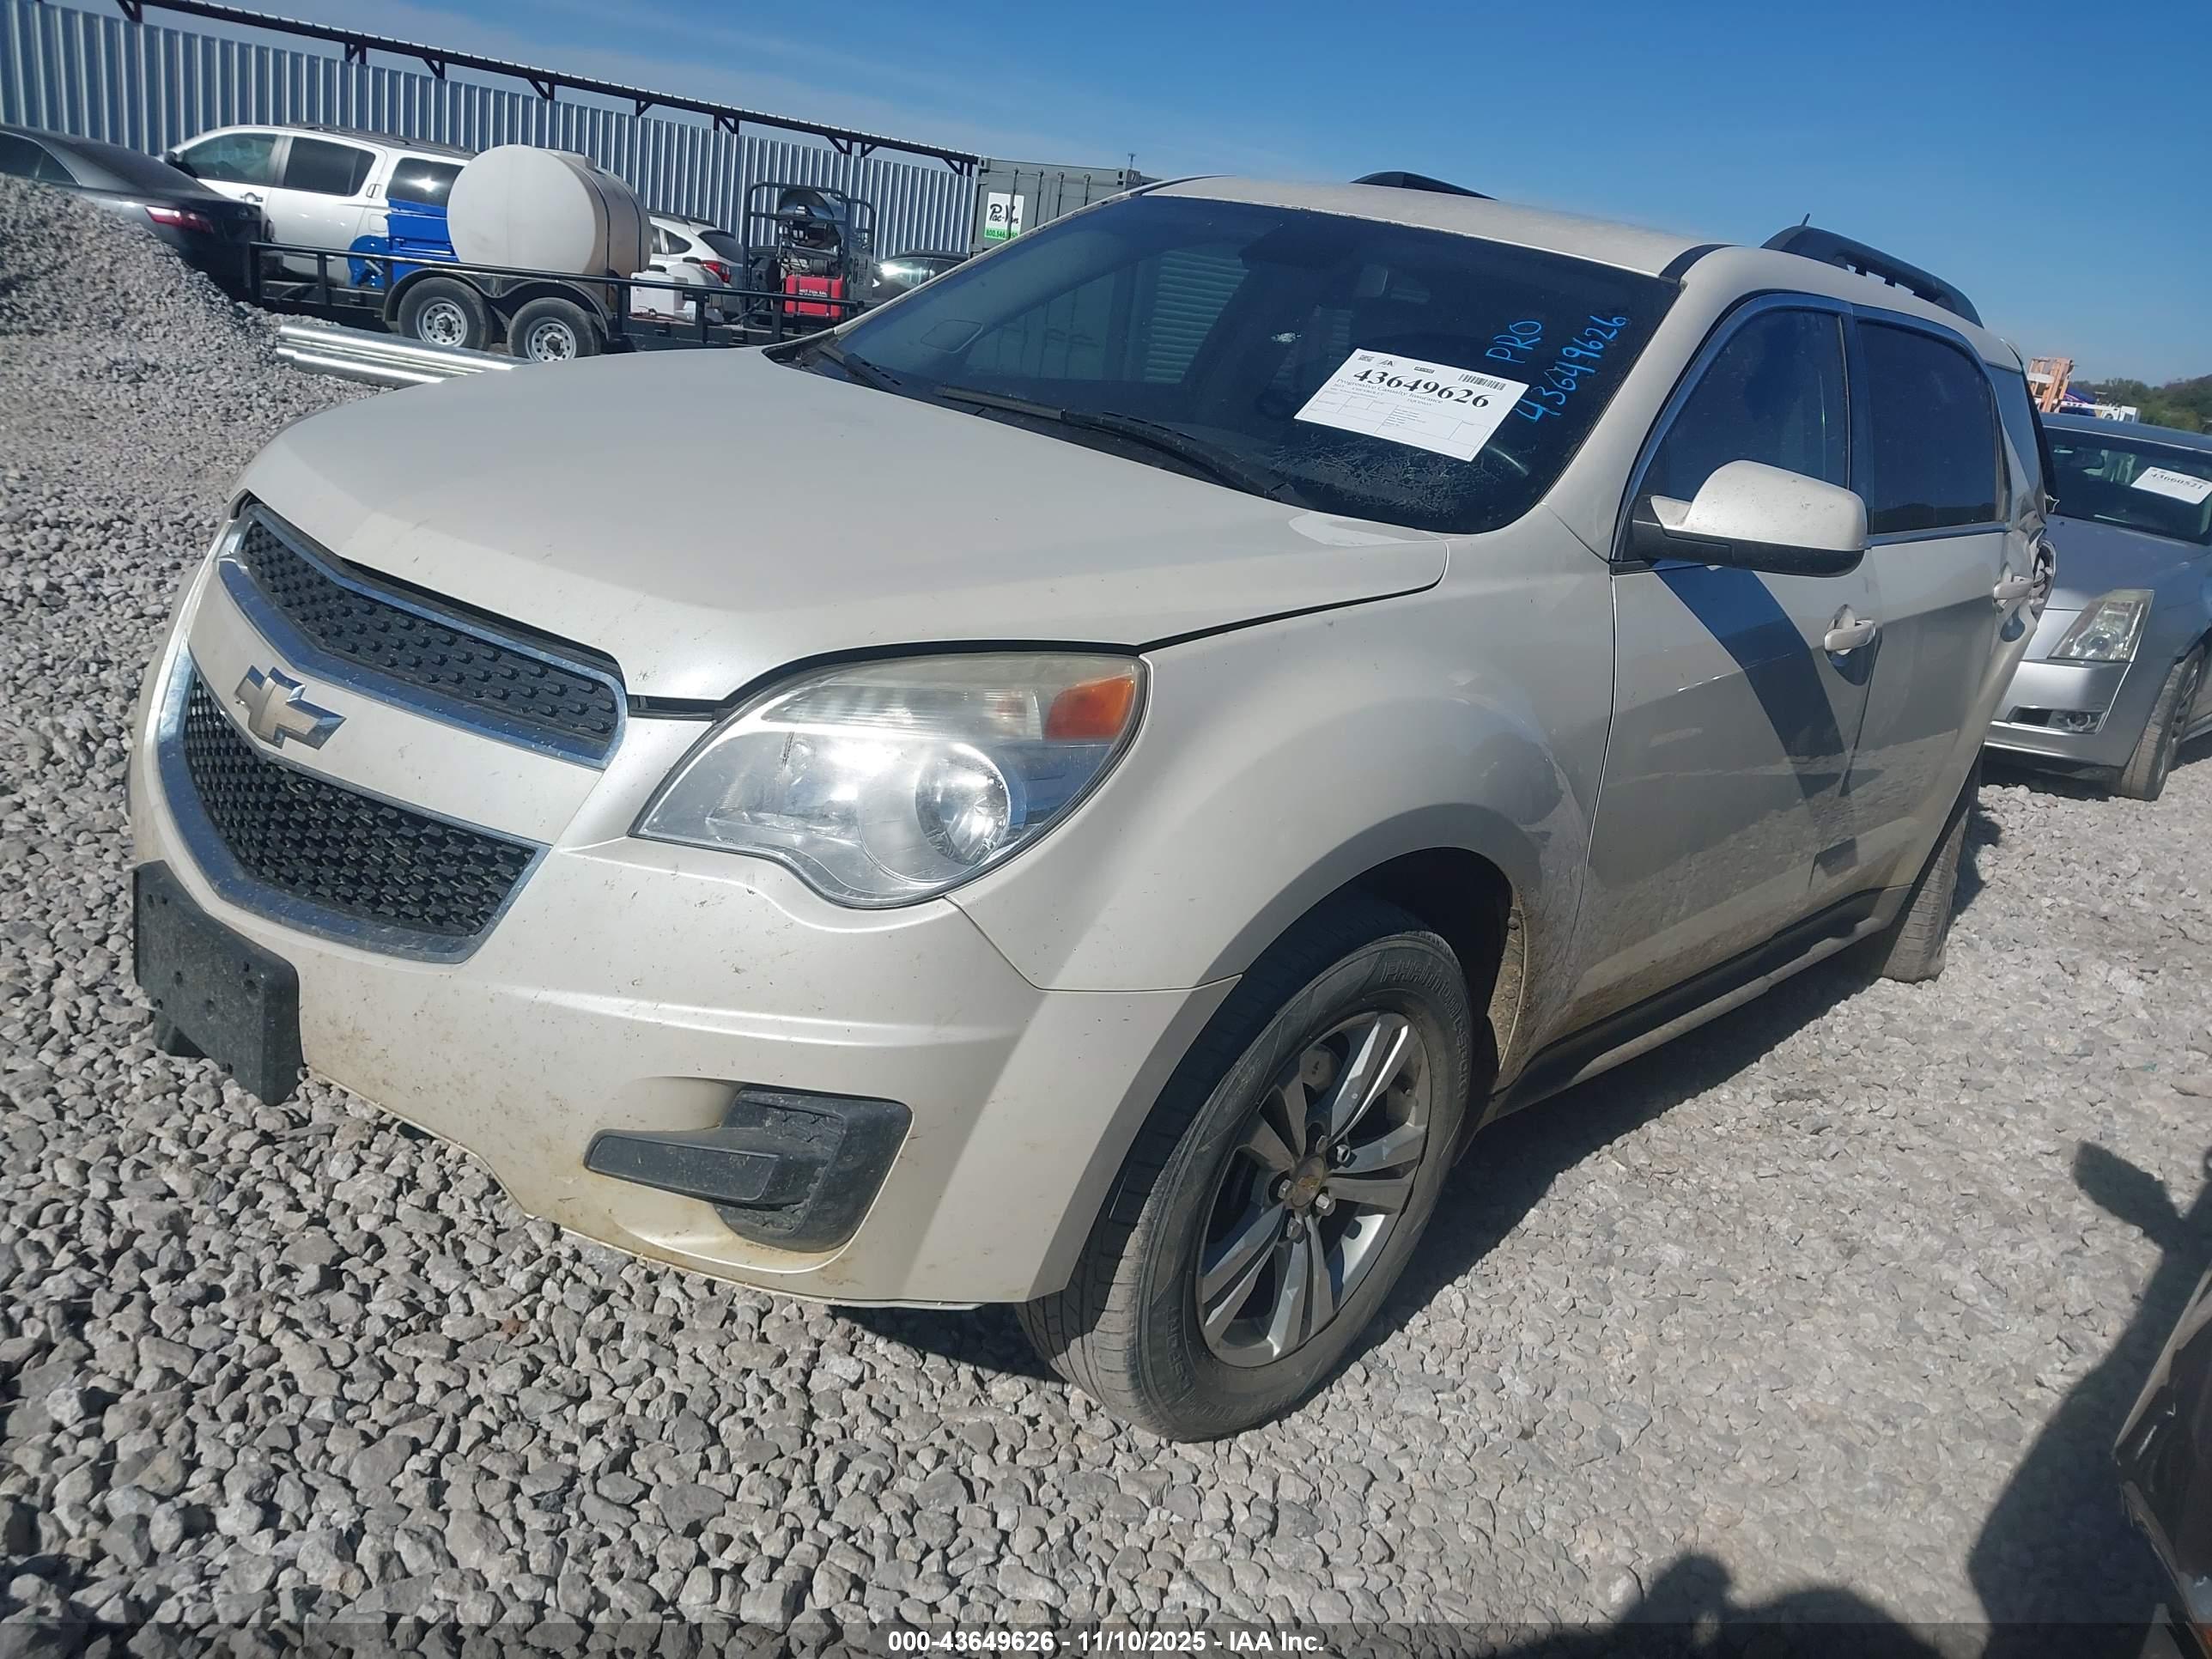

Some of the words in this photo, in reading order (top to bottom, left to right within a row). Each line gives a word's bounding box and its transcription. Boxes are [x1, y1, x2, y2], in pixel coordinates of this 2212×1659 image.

[1485, 320, 1542, 364] PRO
[1353, 368, 1495, 409] 43649626
[1512, 315, 1627, 422] 43649626
